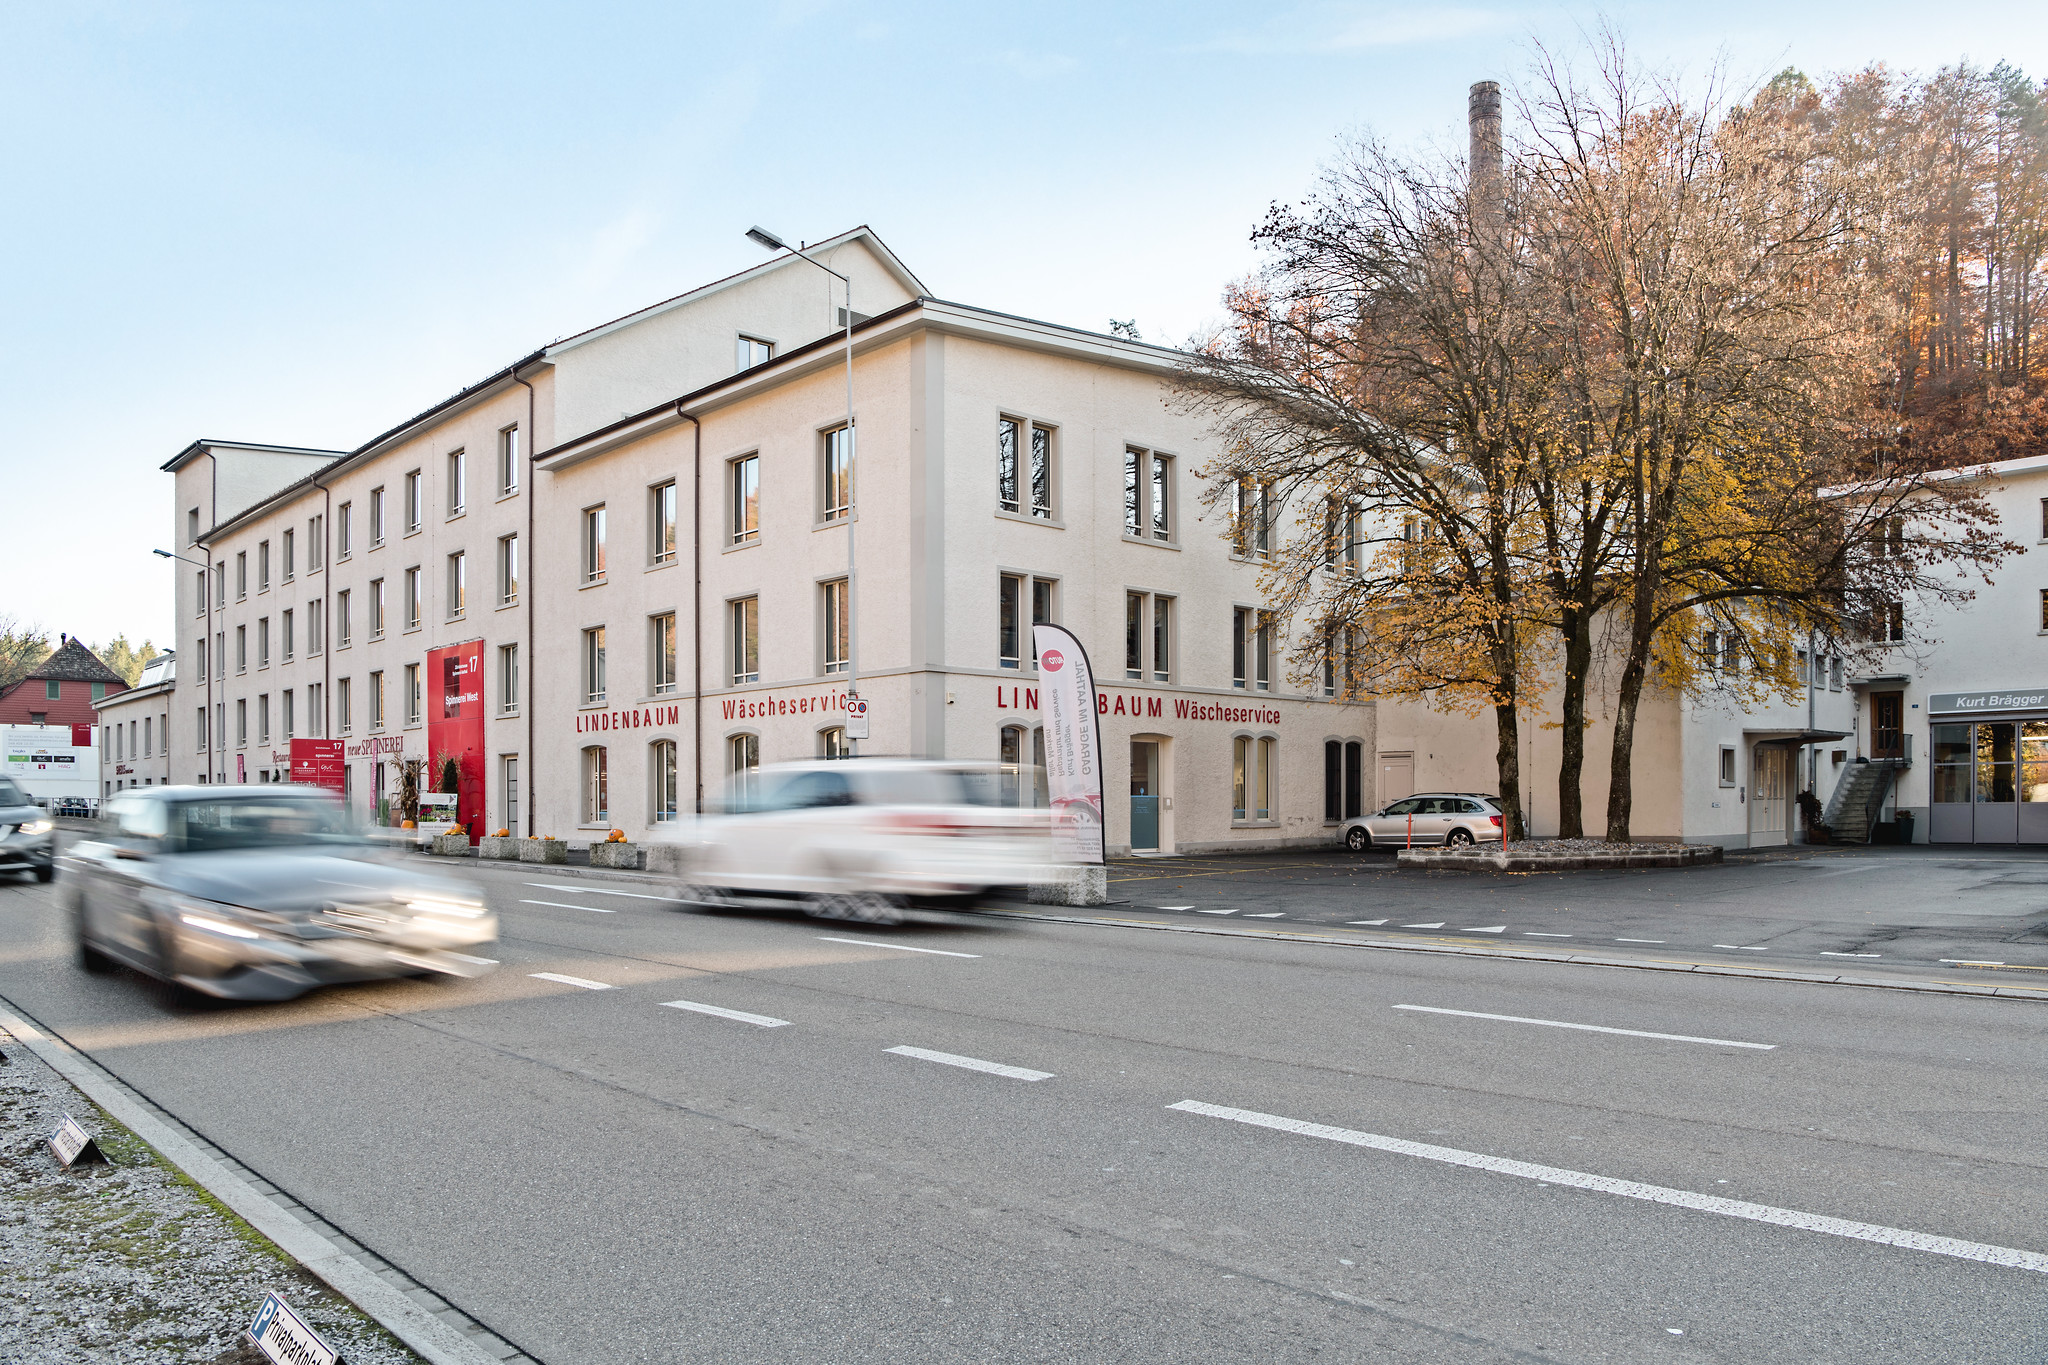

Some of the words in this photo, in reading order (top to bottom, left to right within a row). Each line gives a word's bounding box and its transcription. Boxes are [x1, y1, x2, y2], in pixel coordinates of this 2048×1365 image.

[468, 655, 479, 673] 17
[466, 691, 479, 702] West
[998, 685, 1163, 718] LINBAUM
[1174, 699, 1281, 725] Wäscheservice
[1956, 696, 1986, 708] Kurt
[1988, 694, 2045, 707] Brägger
[576, 705, 679, 733] LINDENBAUM
[722, 688, 859, 720] Wäscheservic
[333, 742, 342, 750] 17
[361, 735, 404, 756] SPINEREI
